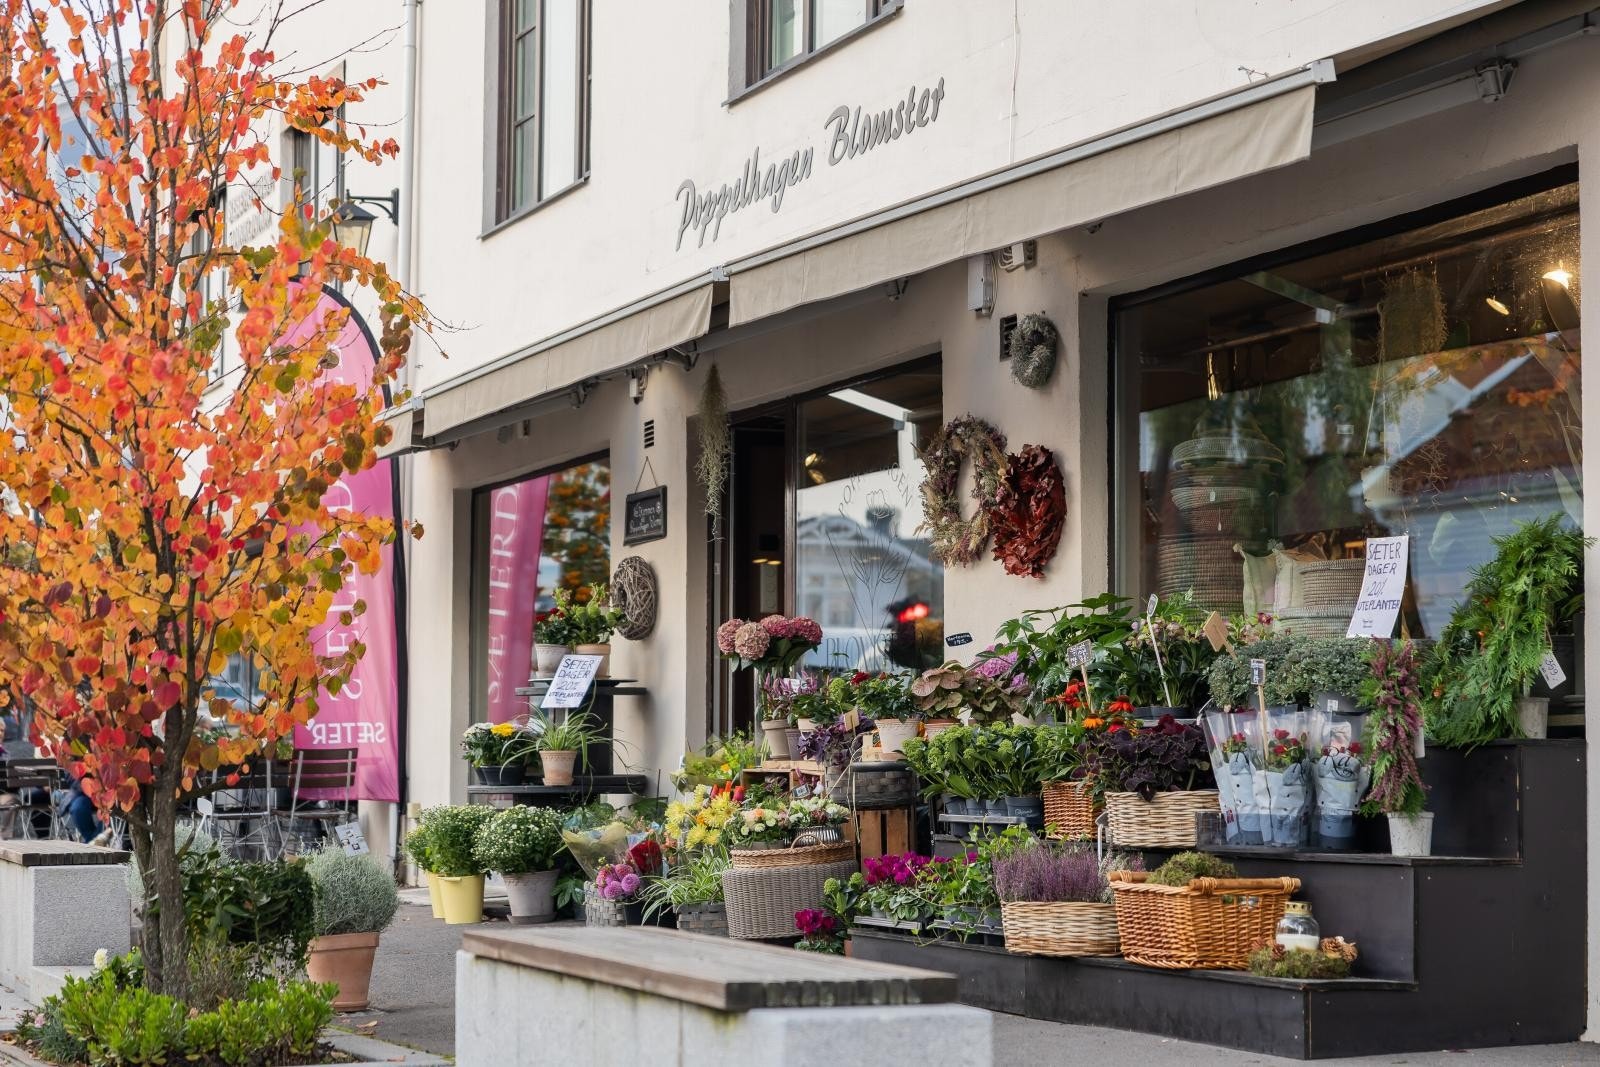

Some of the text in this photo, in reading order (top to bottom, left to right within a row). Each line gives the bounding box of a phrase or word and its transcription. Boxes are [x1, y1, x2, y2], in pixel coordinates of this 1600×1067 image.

[675, 77, 945, 251] Poppelhagen Blomster
[1368, 563, 1397, 576] DAGER
